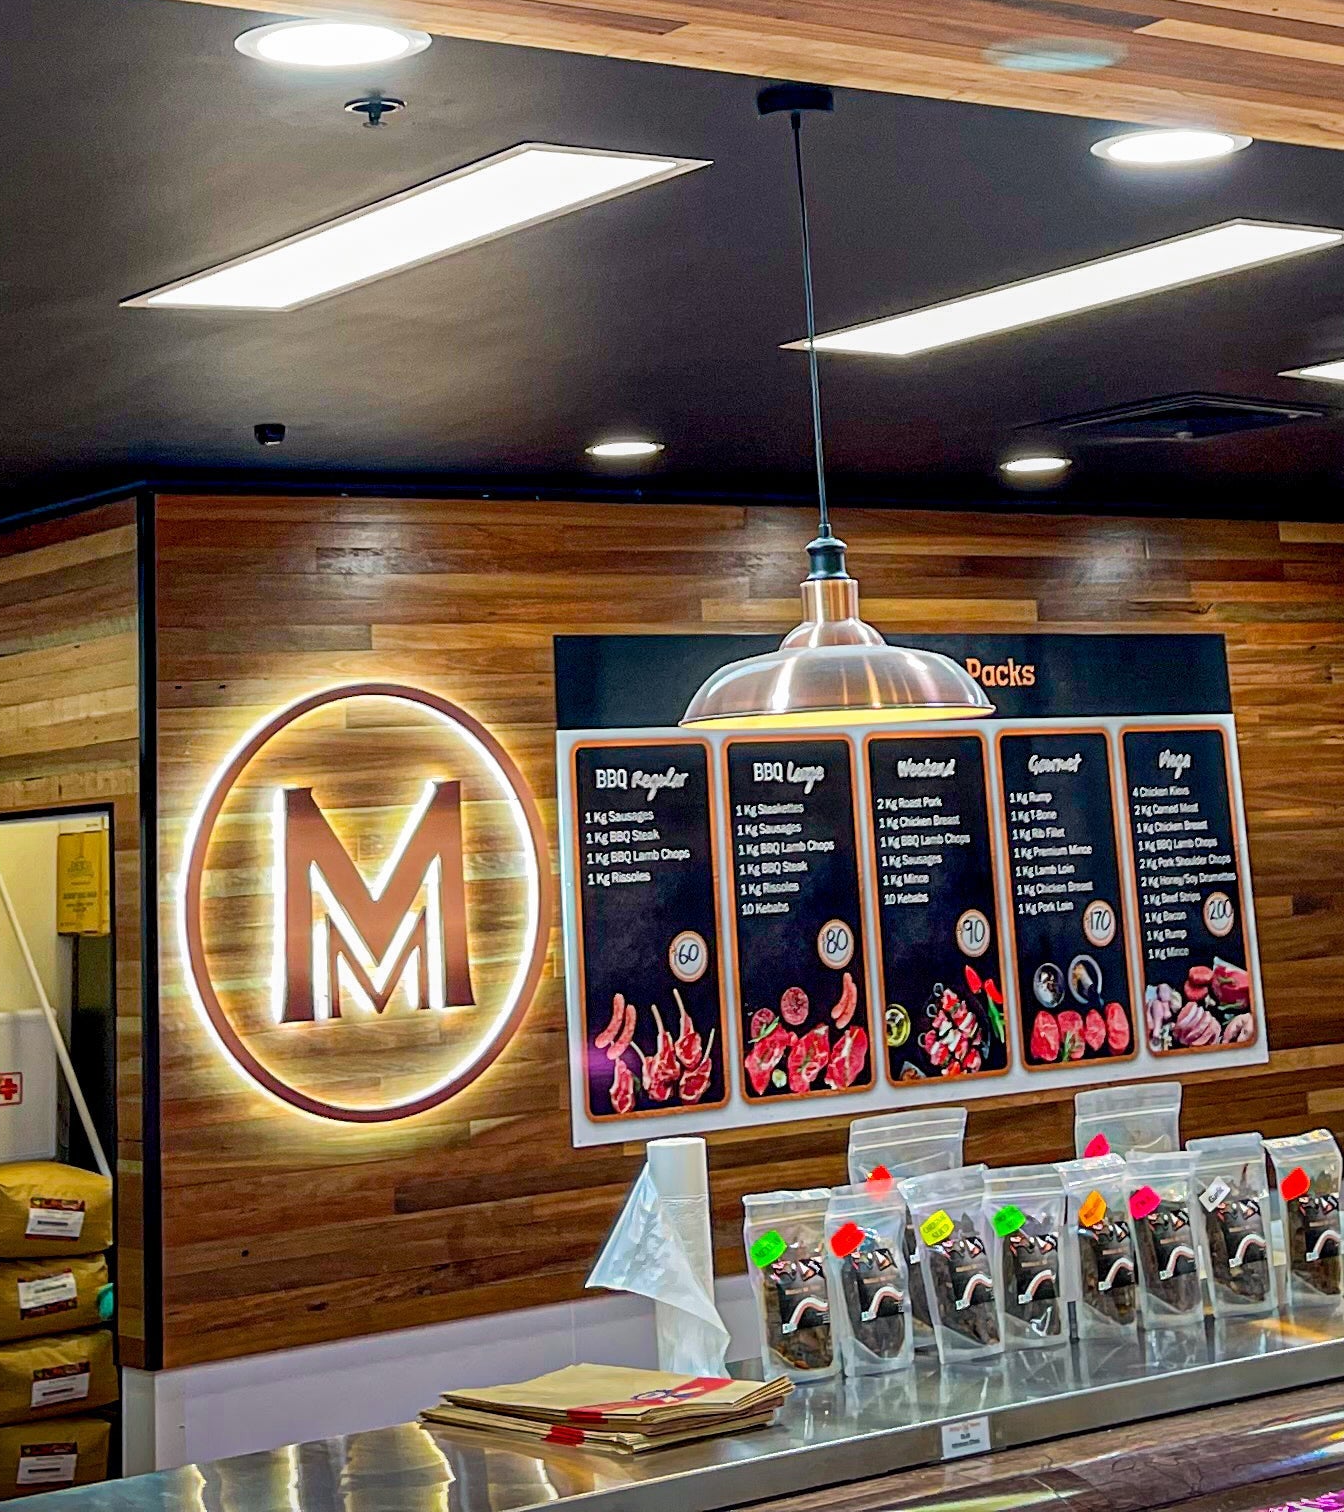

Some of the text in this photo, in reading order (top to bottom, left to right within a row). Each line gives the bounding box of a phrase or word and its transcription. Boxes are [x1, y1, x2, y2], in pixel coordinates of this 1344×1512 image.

[966, 658, 1036, 687] Packs
[897, 758, 955, 777] Weekend
[596, 766, 689, 801] BBQ Regular
[585, 810, 654, 825] 1 Kg Sausages
[736, 805, 742, 815] 1
[586, 829, 660, 845] 1 Kg BBQ Steak
[737, 825, 743, 836] 1
[587, 848, 690, 865] 1 Kg BBQ Lamb Chops
[738, 845, 744, 856] 1
[739, 865, 745, 875] 1
[588, 871, 651, 886] 1 Kg Rissoles
[741, 884, 747, 895] 1
[963, 919, 985, 944] 90
[827, 928, 848, 954] 80
[679, 944, 699, 964] 60
